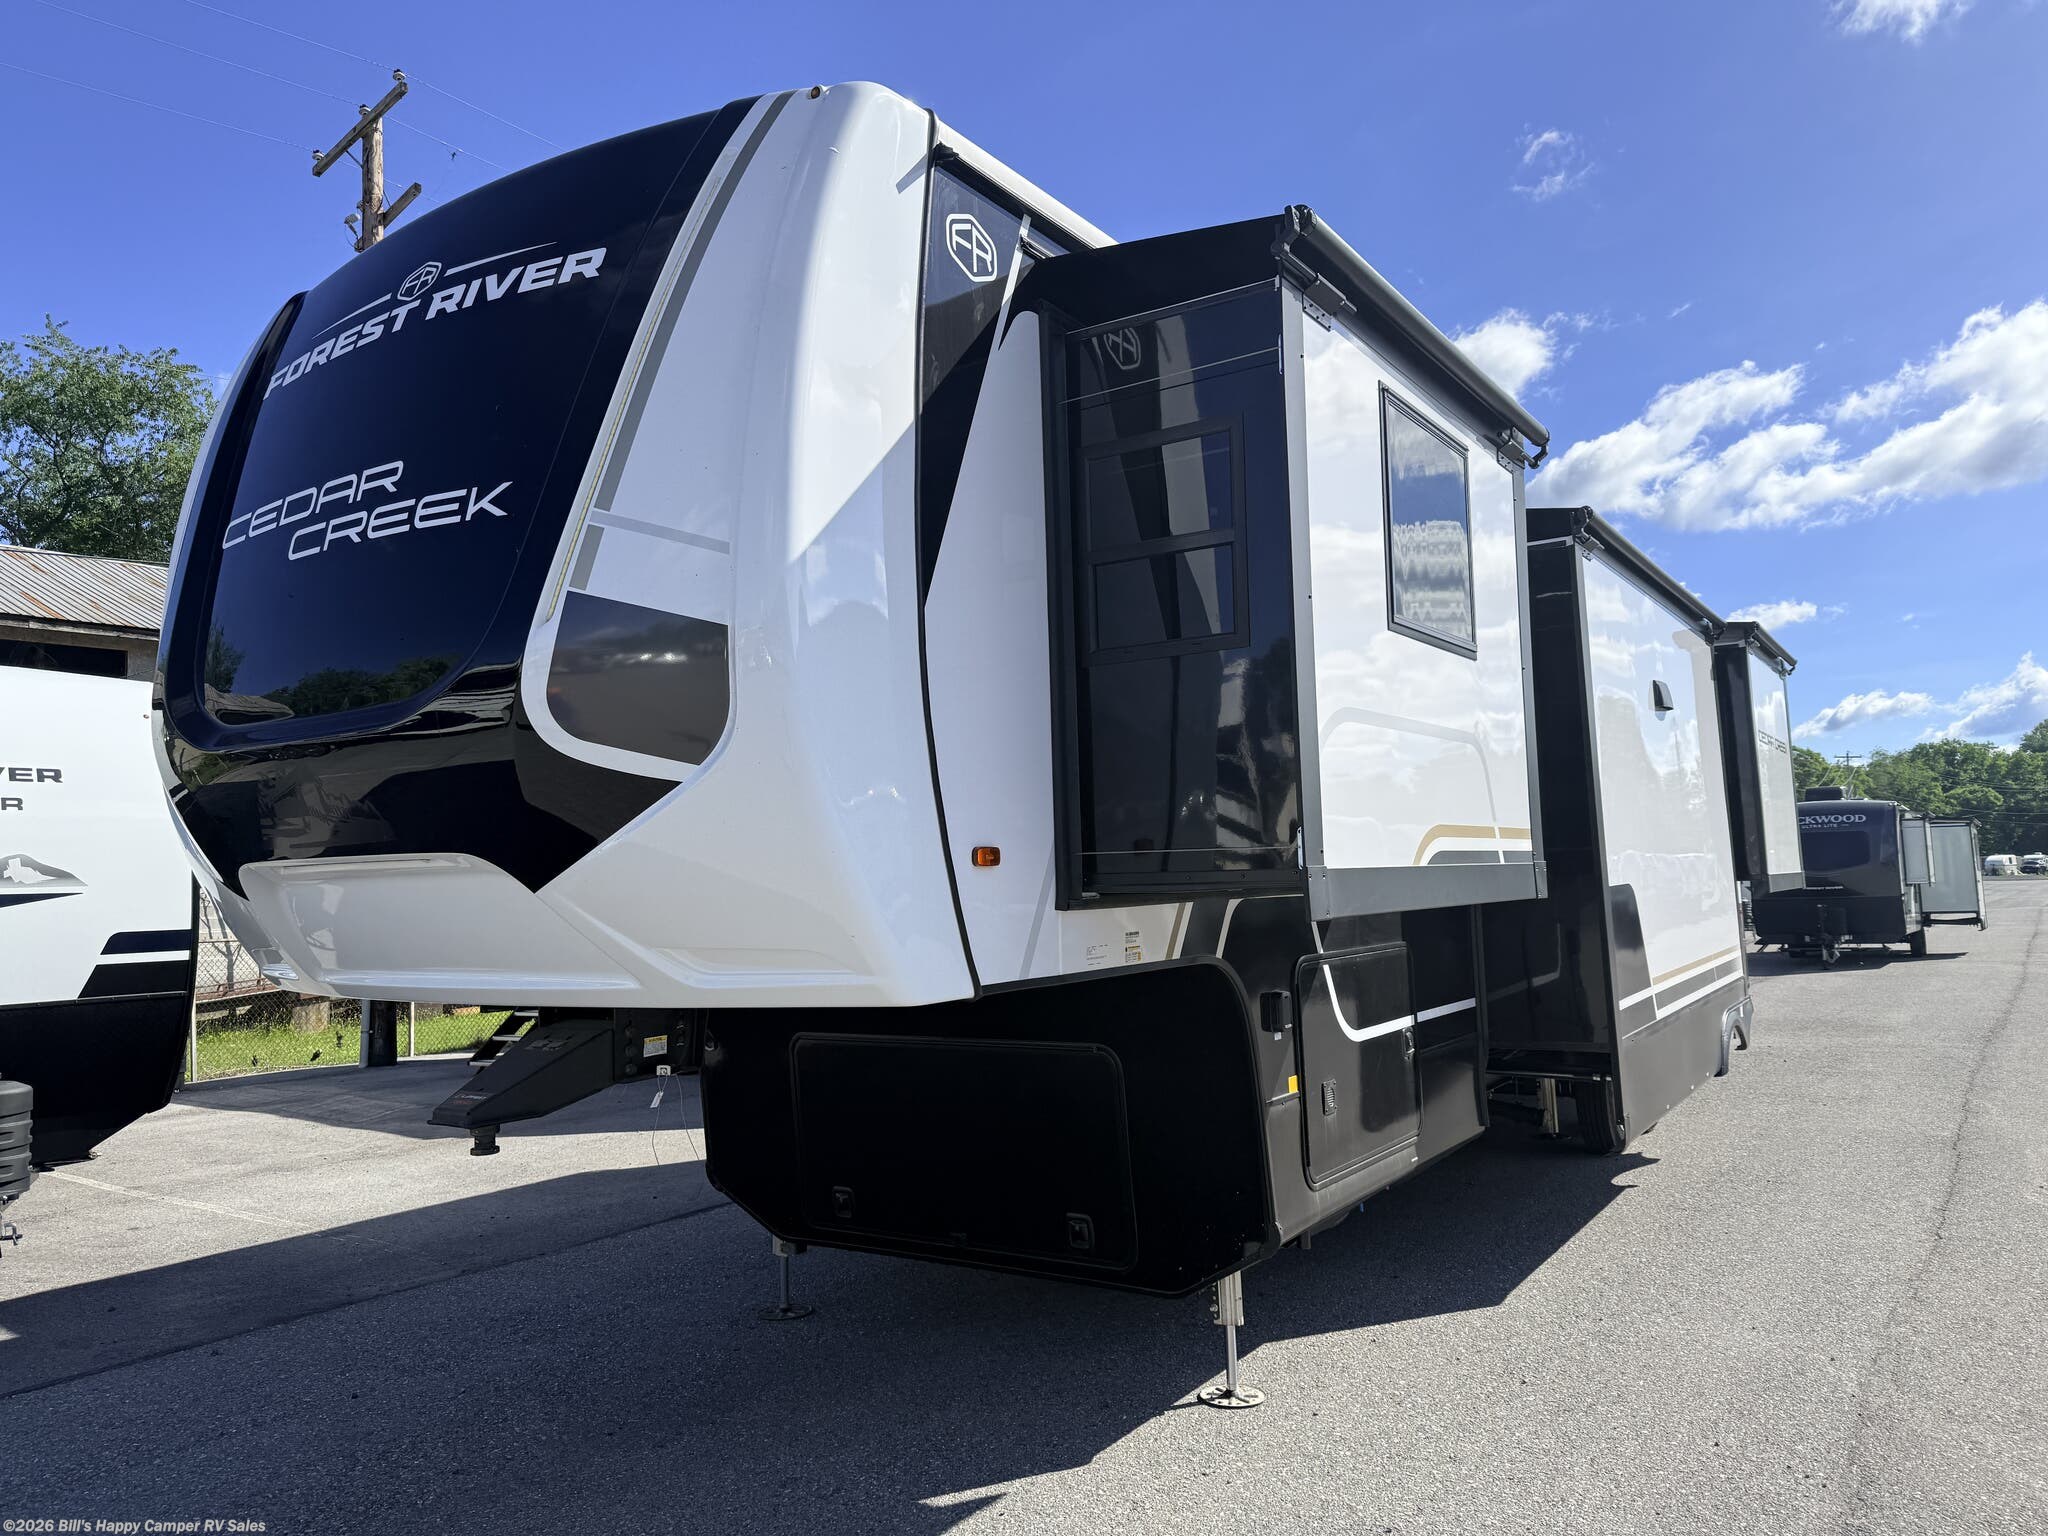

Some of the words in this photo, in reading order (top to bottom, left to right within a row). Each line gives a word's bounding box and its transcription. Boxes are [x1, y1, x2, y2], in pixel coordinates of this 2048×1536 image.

[264, 300, 420, 400] FOREST
[425, 247, 607, 321] RIVER
[222, 460, 404, 549] CEDAR
[288, 481, 513, 560] CREEK
